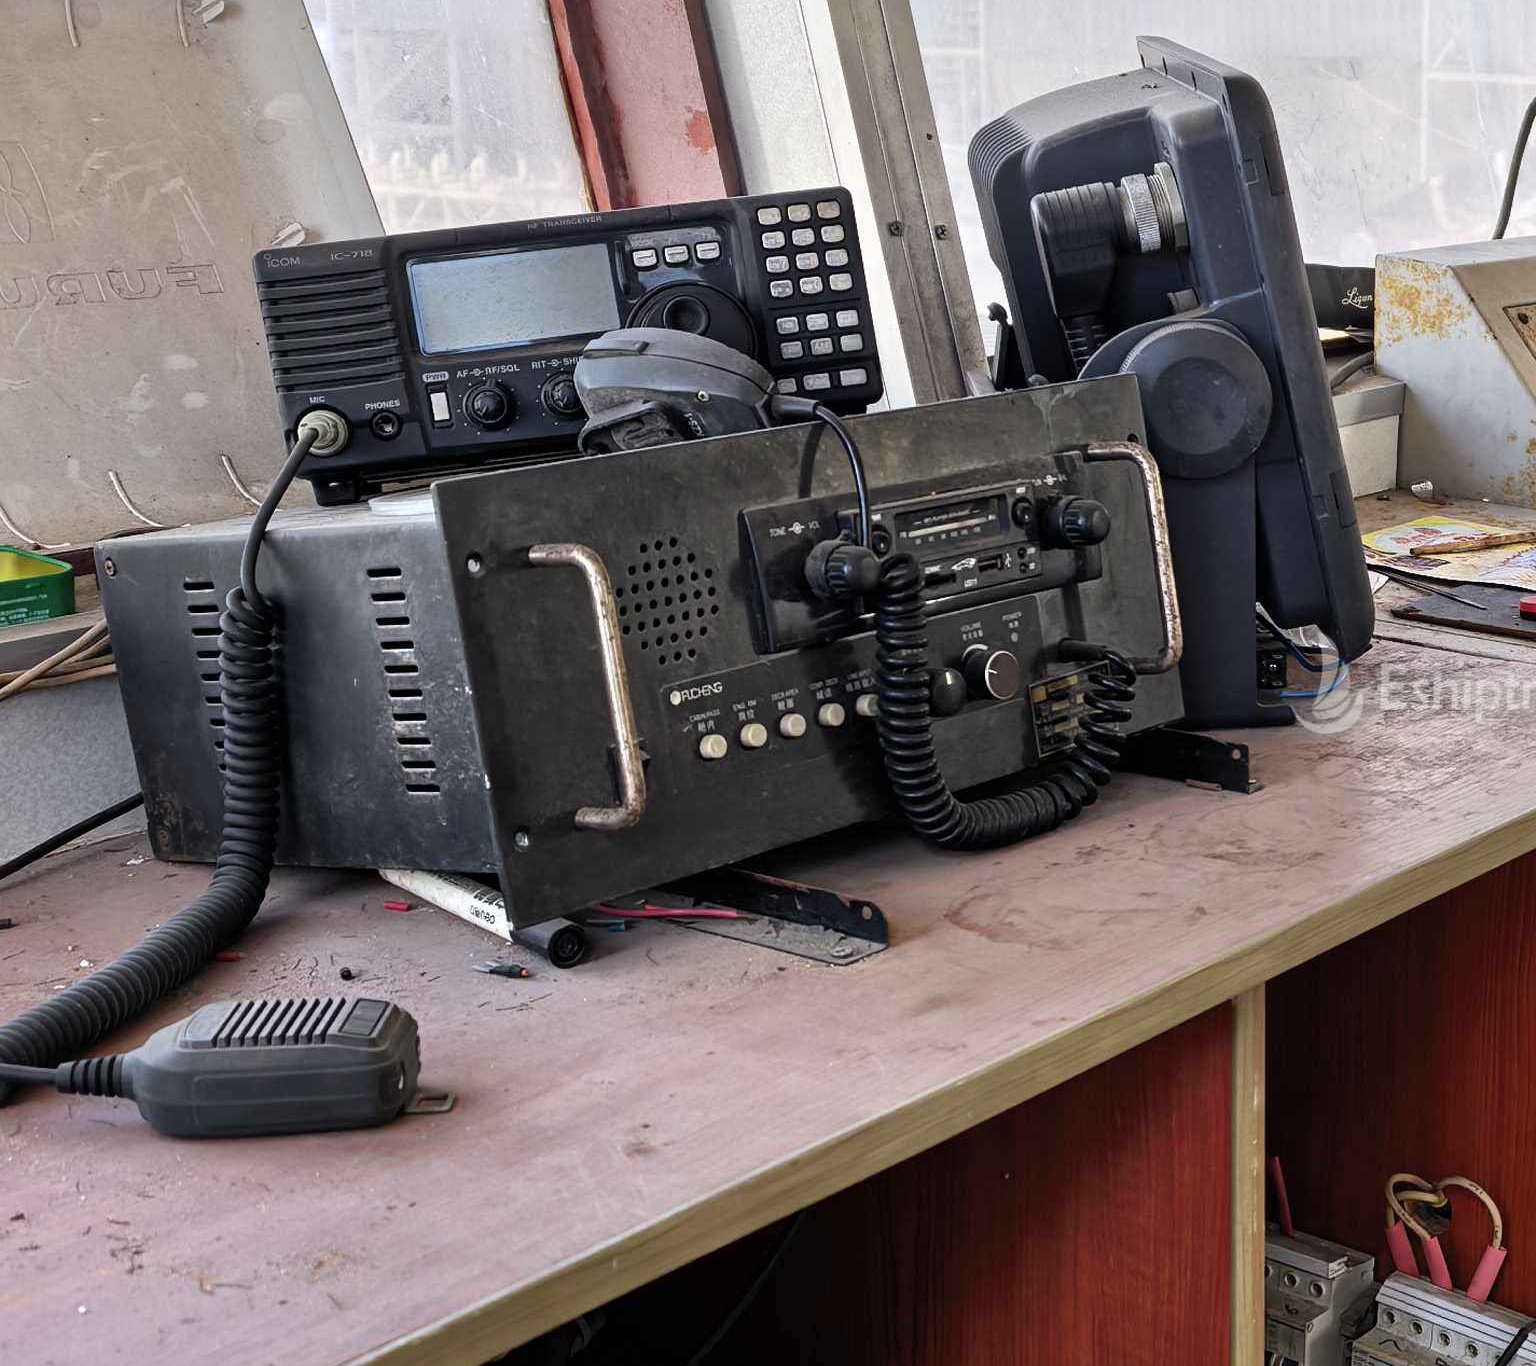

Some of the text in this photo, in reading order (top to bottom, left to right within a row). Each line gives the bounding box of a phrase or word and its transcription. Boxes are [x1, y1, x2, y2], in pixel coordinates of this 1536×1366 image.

[543, 215, 603, 228] TRANSCEIVER
[329, 248, 374, 261] IC-718
[456, 368, 470, 379] AF
[309, 395, 326, 404] MIC
[364, 399, 401, 410] PHONES
[769, 520, 820, 539] TONE VOL
[681, 681, 724, 702] FUCHENG
